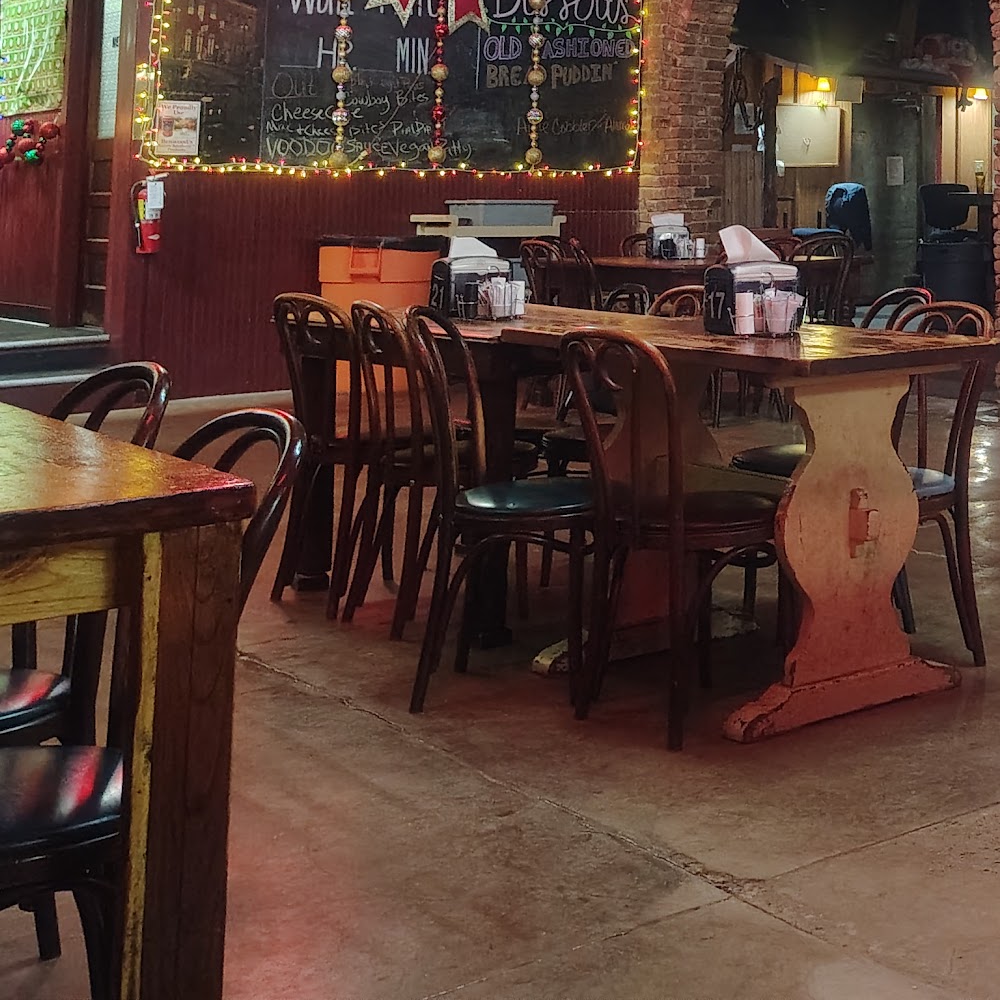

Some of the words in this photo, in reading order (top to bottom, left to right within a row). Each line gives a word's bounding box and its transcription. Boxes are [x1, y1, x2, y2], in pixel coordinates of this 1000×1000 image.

[483, 35, 523, 61] OLD
[531, 37, 636, 60] ASHIONED
[707, 291, 726, 320] 17
